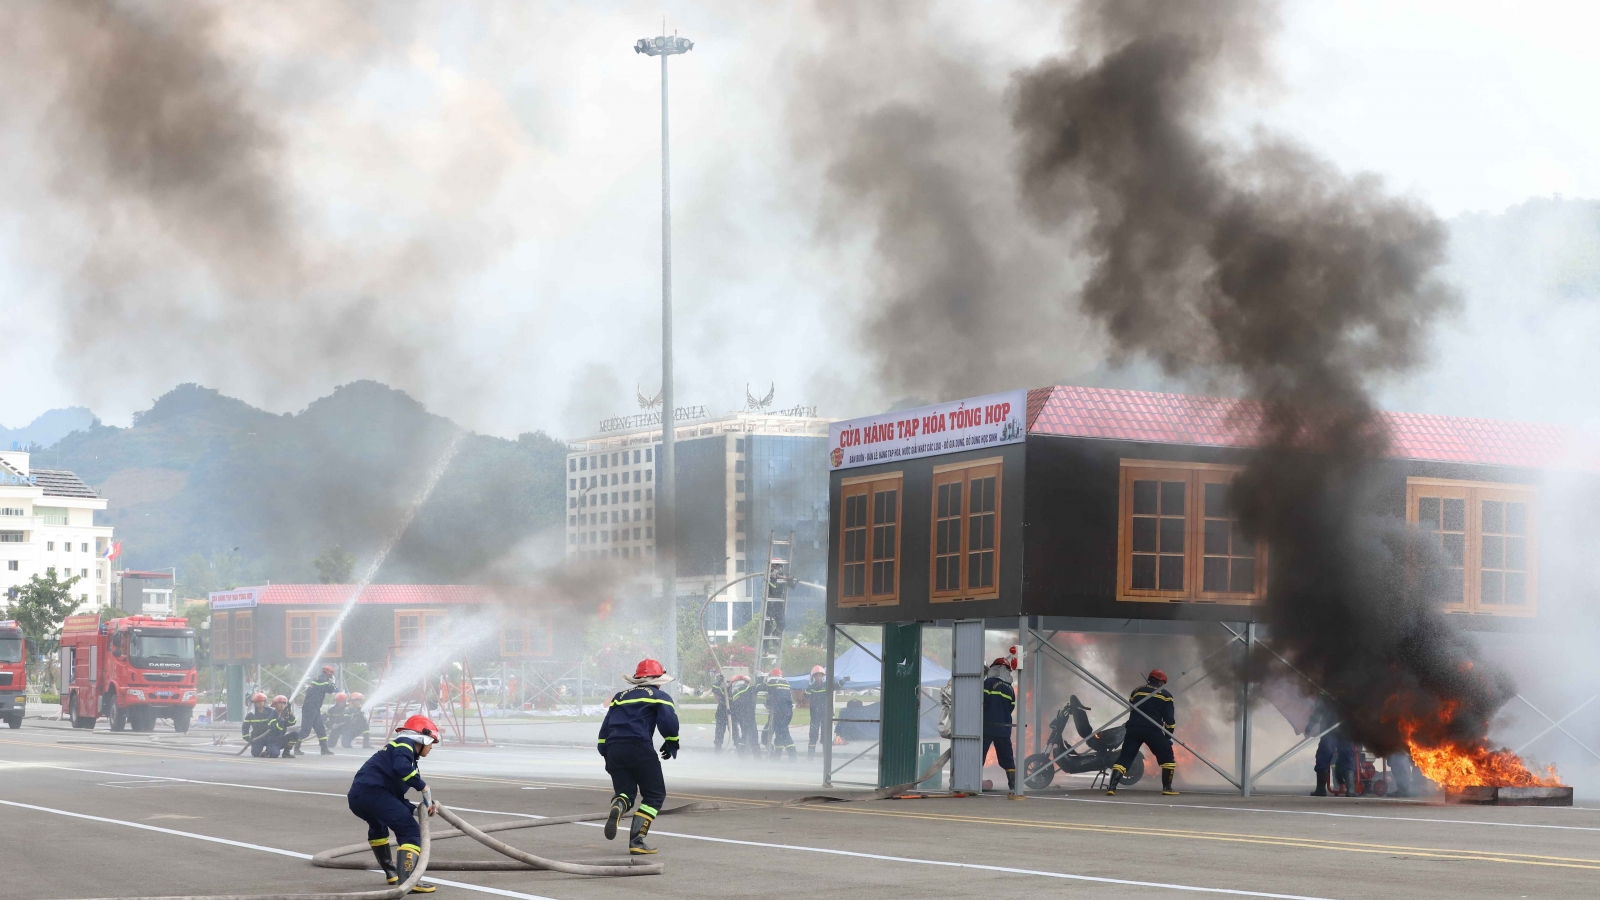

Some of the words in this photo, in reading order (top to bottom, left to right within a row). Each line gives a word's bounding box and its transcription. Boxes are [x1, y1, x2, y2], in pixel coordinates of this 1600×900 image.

[840, 425, 861, 448] CỬA
[863, 422, 894, 445] HÀNG
[898, 419, 919, 441] TẠP
[922, 411, 946, 434] HÓA
[949, 402, 982, 430] TỔNG
[985, 402, 1011, 427] HỢP
